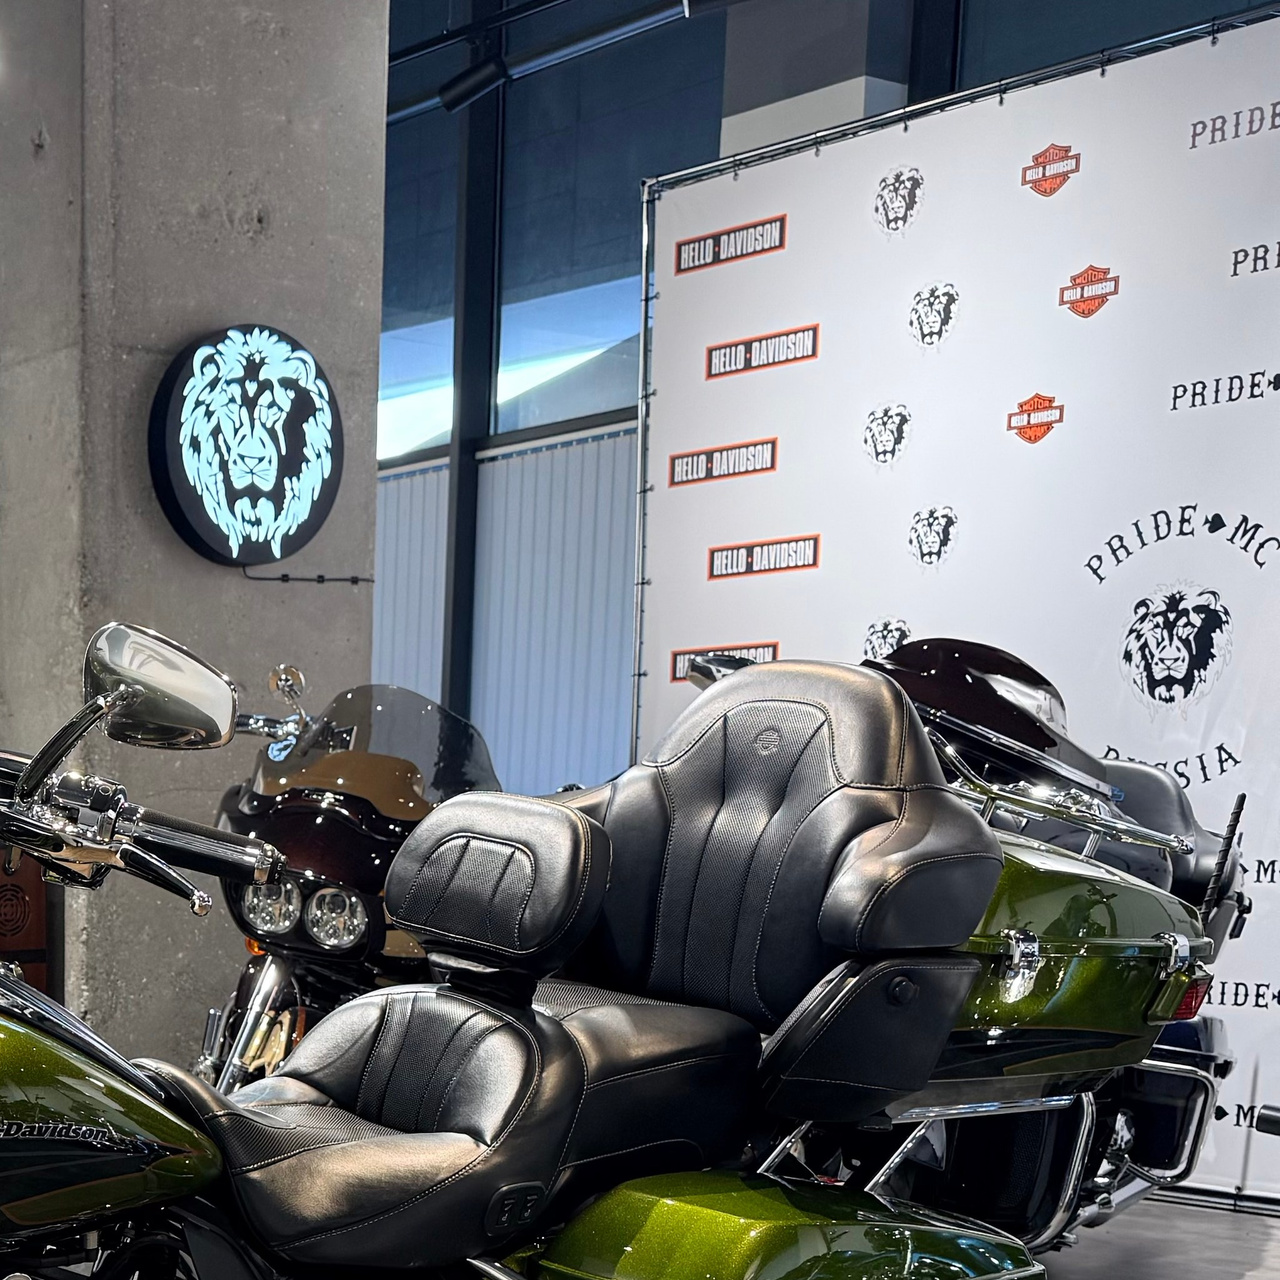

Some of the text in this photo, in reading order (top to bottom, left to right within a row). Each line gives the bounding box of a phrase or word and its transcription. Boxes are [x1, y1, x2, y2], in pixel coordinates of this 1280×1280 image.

[680, 221, 781, 270] HELLO DAVIDSON
[1075, 270, 1104, 285] MOTOR
[711, 330, 814, 375] HELLO DAVIDSON
[1170, 370, 1267, 411] PRIDE
[673, 443, 772, 483] HELLO DAVIDSON
[712, 539, 815, 576] HELLO DAVIDSON
[1083, 503, 1280, 585] PRIDE MC
[1205, 981, 1271, 1010] IDE
